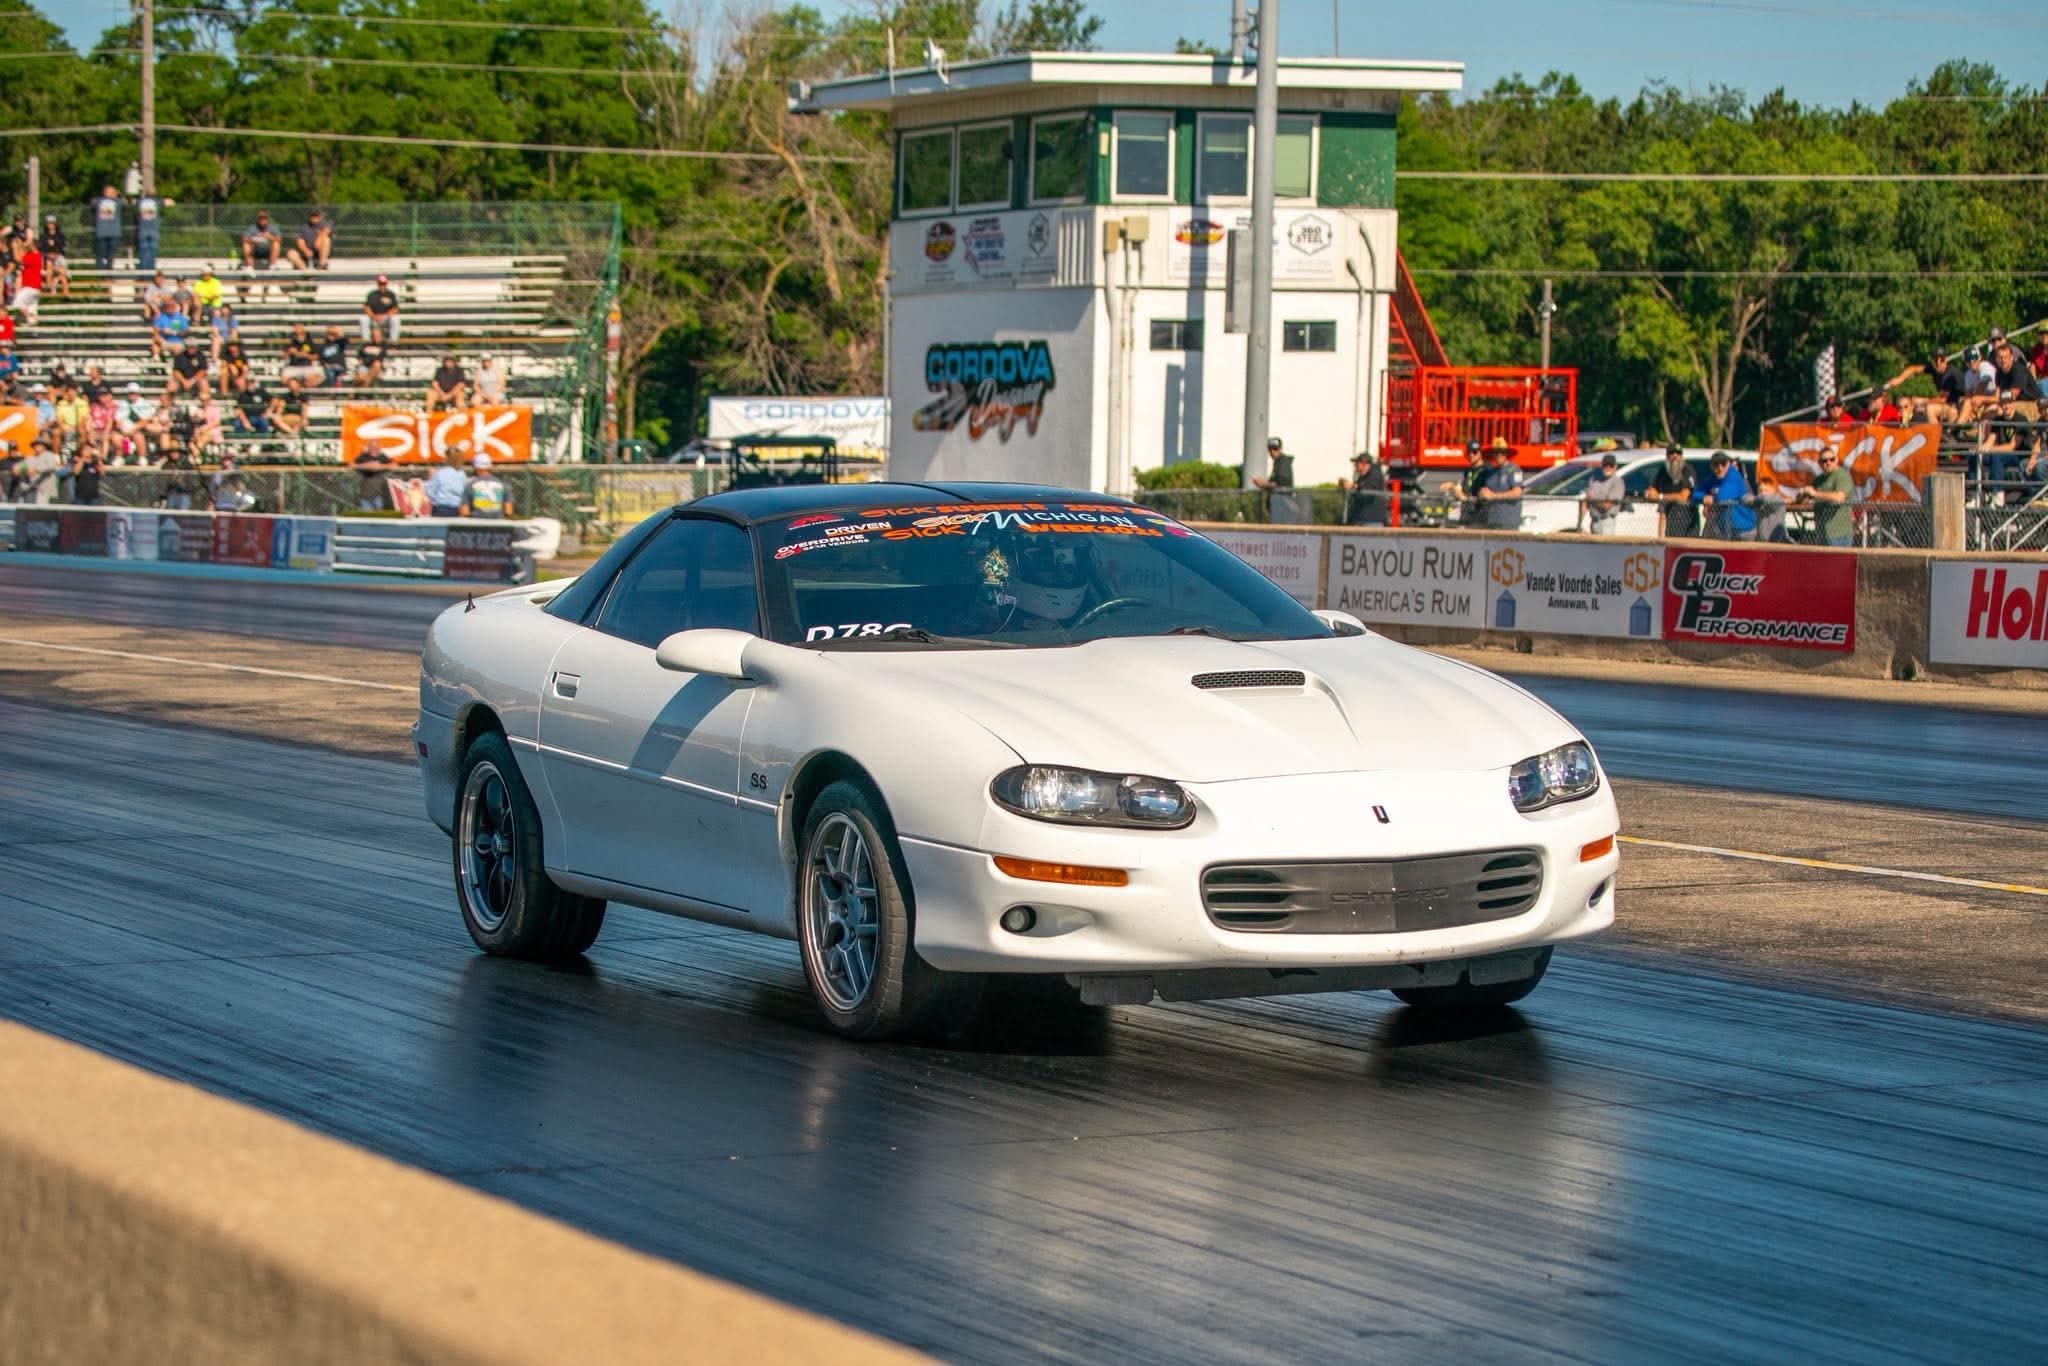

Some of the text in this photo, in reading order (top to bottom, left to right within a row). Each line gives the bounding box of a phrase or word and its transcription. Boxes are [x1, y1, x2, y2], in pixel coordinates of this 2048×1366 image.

[926, 340, 1055, 389] CORDOVA
[824, 521, 893, 536] DRIVEN
[971, 510, 1134, 536] MICHIGAN
[777, 533, 866, 554] OVERDRIVE
[1271, 542, 1308, 559] Illinois
[1340, 543, 1475, 581] BAYOU RUM
[1491, 548, 1526, 588] GSI
[1624, 552, 1661, 593] GSI
[1668, 552, 1767, 599] QUICK
[1526, 572, 1623, 596] Vande Voorde Sales
[1338, 585, 1472, 616] AMERICA'S RUM
[1548, 596, 1600, 611] Annawan, IL
[1674, 593, 1849, 644] PERFORMANCE
[751, 772, 768, 790] SS
